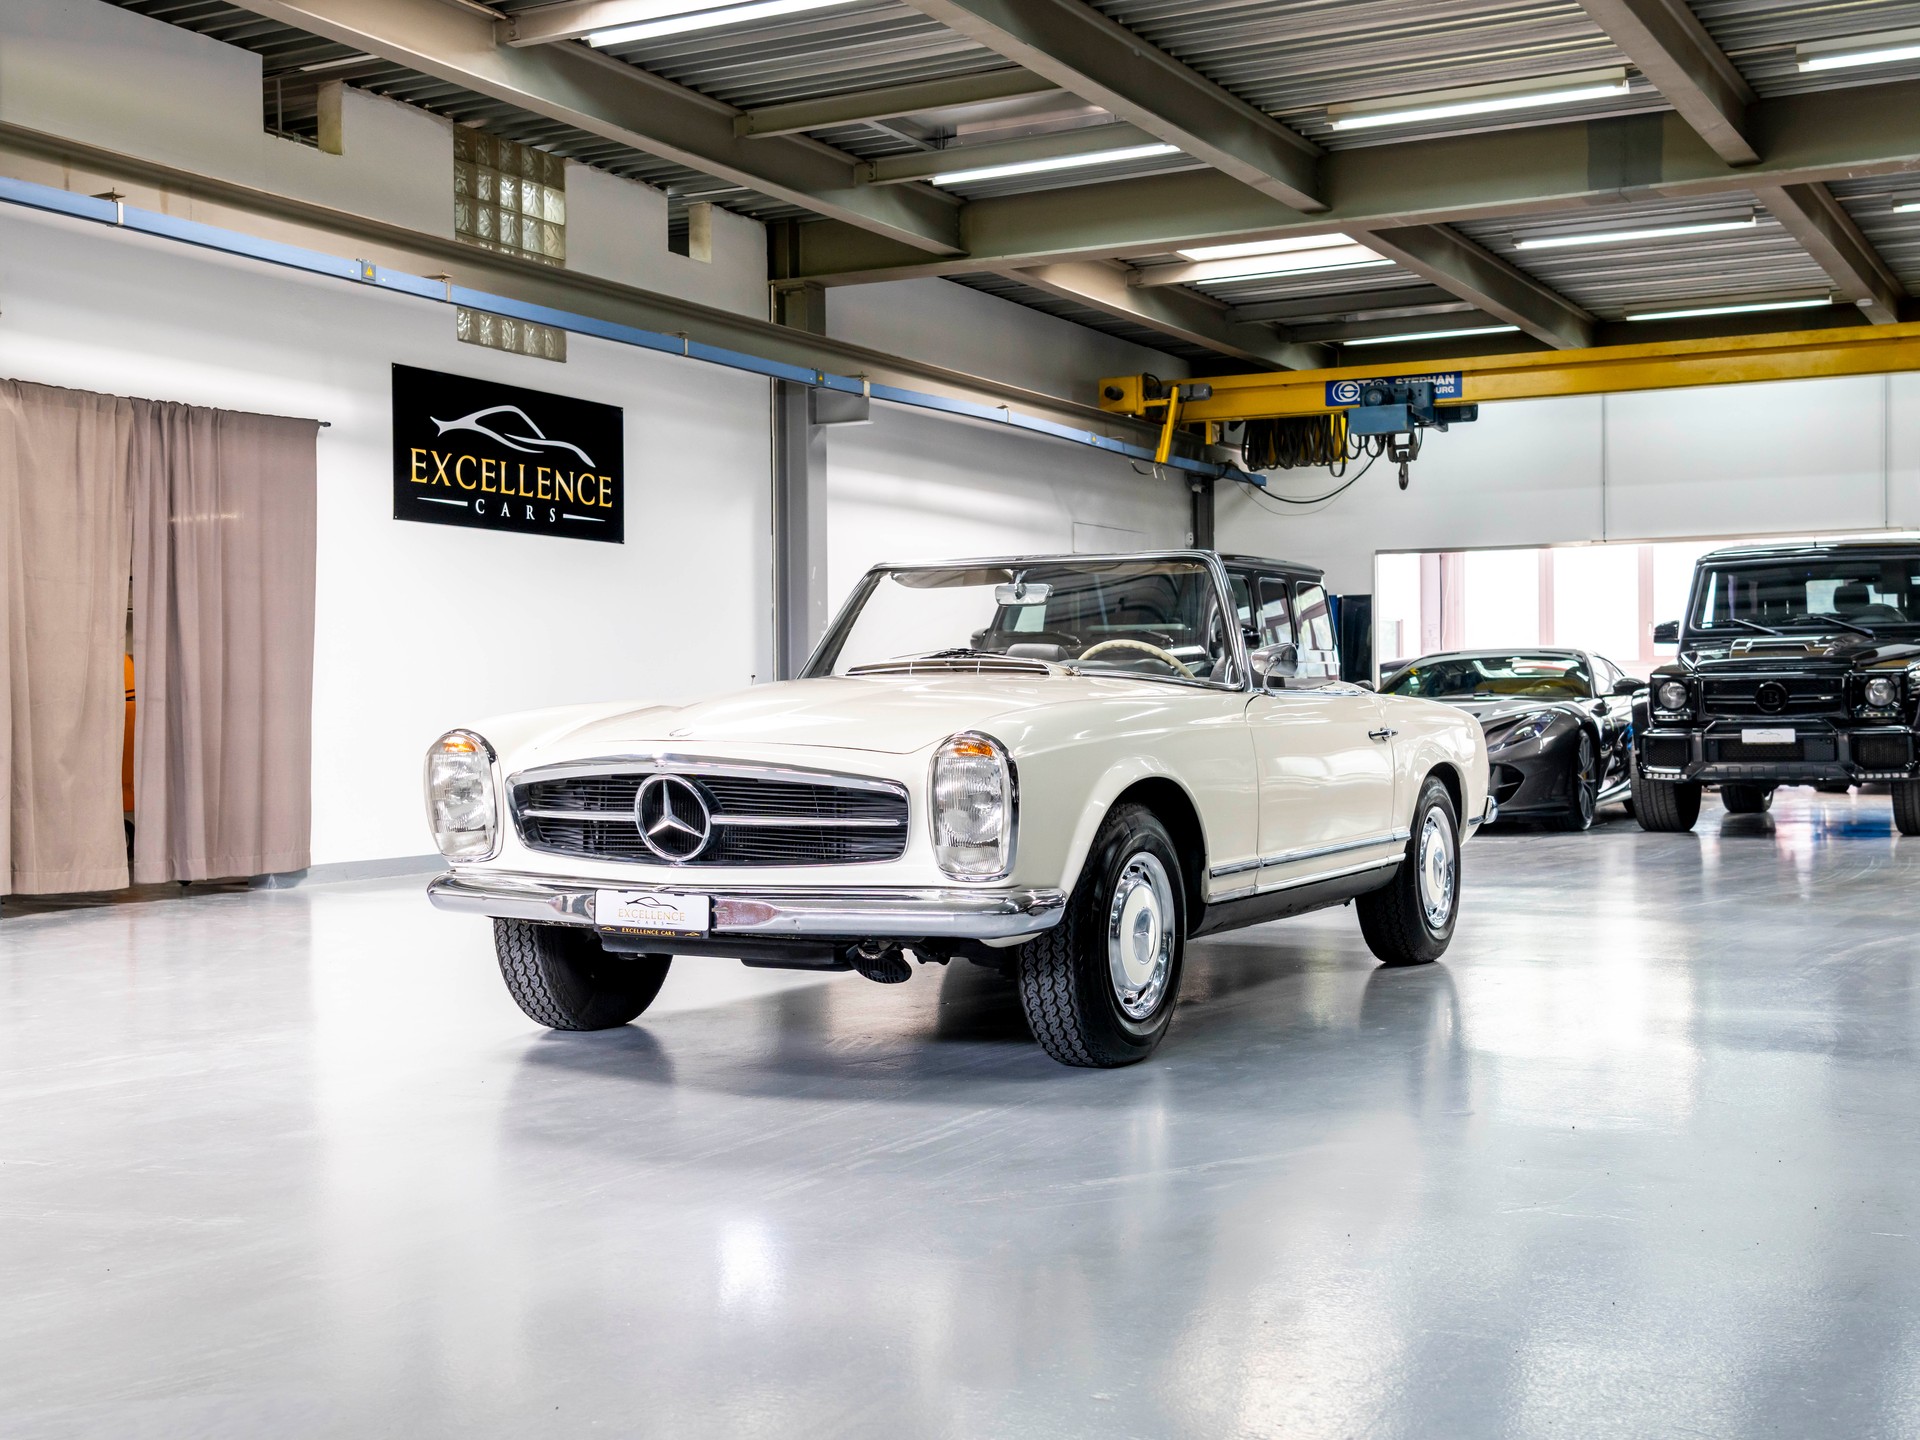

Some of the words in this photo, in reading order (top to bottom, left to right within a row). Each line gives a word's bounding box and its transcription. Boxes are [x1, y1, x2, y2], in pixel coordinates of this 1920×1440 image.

[410, 447, 613, 508] EXCELLENCE
[475, 498, 556, 523] CARS
[618, 908, 686, 922] EXCELLENCE
[621, 926, 659, 936] EXCELLENCE
[660, 929, 676, 937] CARS
